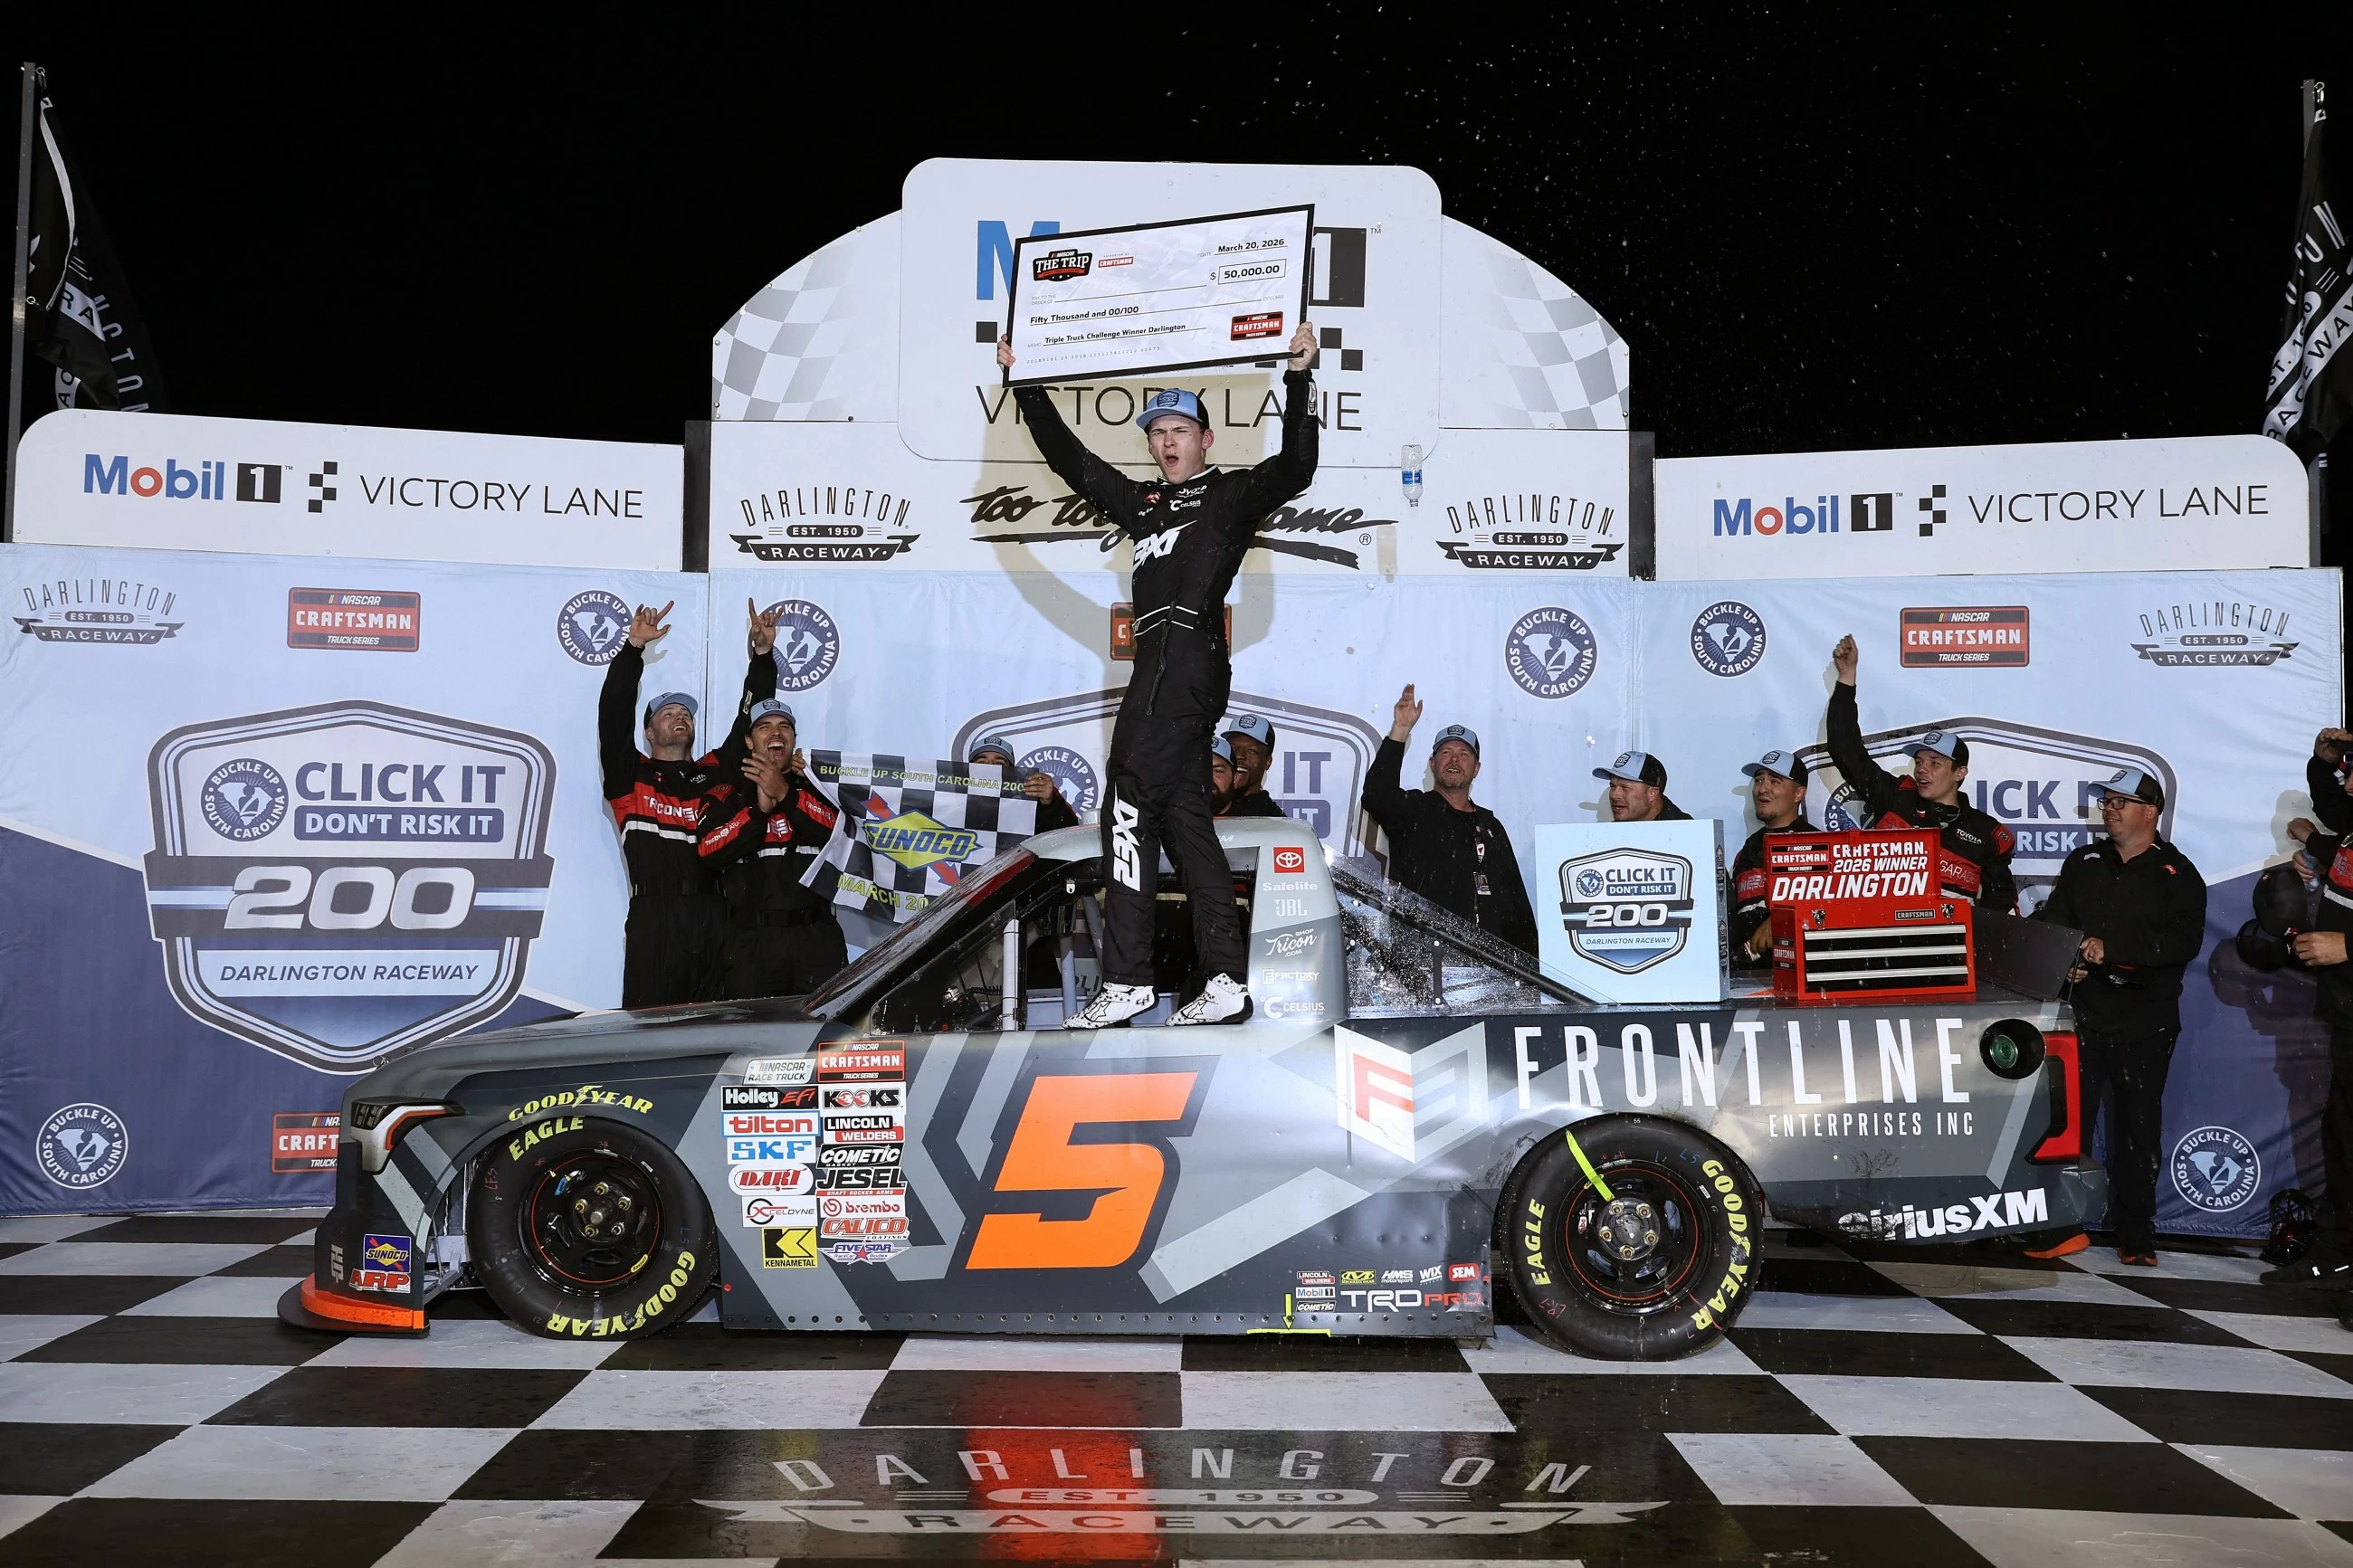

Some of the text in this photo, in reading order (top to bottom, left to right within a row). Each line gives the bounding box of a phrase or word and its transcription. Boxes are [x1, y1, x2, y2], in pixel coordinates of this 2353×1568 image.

[1218, 238, 1284, 253] March 20, 2026
[1035, 254, 1090, 273] THE TRIP
[1100, 257, 1132, 268] CRAFTSMAN
[1210, 265, 1280, 280] $ 50,000.00
[1030, 306, 1138, 325] Fifty Thousand and 00/100
[1045, 323, 1186, 346] Triple Truck Challenge Winner Darlington
[1234, 320, 1280, 332] CRAFTSMAN
[83, 453, 224, 501] Mobil
[359, 475, 643, 518] VICTORY LANE
[1968, 485, 2269, 524] VICTORY LANE
[740, 486, 911, 527] DARLINGTON
[1253, 493, 1399, 534] ame
[1446, 494, 1615, 536] DARLINGTON
[1714, 495, 1839, 537] Mobil
[792, 527, 858, 536] EST. 1950
[1498, 534, 1563, 544] EST. 1950
[771, 546, 881, 559] RACEWAY
[1476, 555, 1586, 566] RACEWAY
[24, 579, 176, 617] DARLINGTON
[341, 594, 381, 605] NASCAR
[567, 593, 626, 614] BUCKLE UP
[70, 613, 129, 622] EST. 1950
[296, 611, 412, 630] CRAFTSMAN
[1515, 611, 1587, 637] BUCKLE UP
[1699, 604, 1758, 627] BUCKLE UP
[1950, 613, 1990, 622] NASCAR
[2139, 602, 2290, 637] DARLINGTON
[51, 630, 148, 641] RACEWAY
[327, 635, 380, 645] TRUCK SERIES
[561, 622, 584, 659] SOUTH
[1907, 629, 2021, 645] CRAFTSMAN
[1694, 633, 1763, 674] SOUTH CAROLINA
[1939, 653, 1990, 661] TRUCK SERIES
[2167, 654, 2264, 664] RACEWAY
[1510, 647, 1593, 695] SOUTH CAROLINA
[211, 762, 280, 785] BUCKLE UP
[295, 762, 506, 803] CLICK IT
[820, 765, 1024, 793] BUCKLE UP SOUTH CAROLINA 200
[205, 794, 285, 838] SOUTH CAROLINA
[305, 813, 493, 836] DON'T RISK IT
[866, 824, 969, 856] SUNOCO
[1956, 828, 1983, 842] TOYOTA
[2017, 832, 2079, 852] RISK
[1772, 853, 1827, 864] CRAFTSMAN
[1833, 841, 1924, 858] CRAFTSMAN
[1605, 867, 1676, 882] CLICK IT
[1833, 857, 1928, 873] 2026 WINNER
[837, 874, 929, 912] MARCH 20
[1262, 881, 1318, 891] Safelite
[1609, 885, 1672, 894] DON'T RISK IT
[1771, 871, 1929, 901] DARLINGTON
[224, 865, 476, 931] 200
[1275, 898, 1308, 917] JBL
[1586, 903, 1669, 927] 200
[1897, 909, 1934, 919] CRAFTSMAN
[1295, 928, 1315, 937] SHOP
[1586, 937, 1634, 946] DARLINGTON
[1265, 933, 1318, 956] Tricon
[1284, 949, 1302, 957] .COM
[220, 965, 480, 982] DARLINGTON RACEWAY
[1283, 1001, 1324, 1012] CELSIUS
[852, 1043, 880, 1051] NASCAR
[768, 1061, 805, 1071] NASCAR
[822, 1055, 900, 1069] CRAFTSMAN
[1515, 1018, 1970, 1109] FRONTLINE
[748, 1073, 805, 1081] RACE TRUCK
[508, 1085, 653, 1122] GOODYEAR
[725, 1088, 817, 1107] Holley EFI
[823, 1088, 901, 1109] KOOKS
[48, 1108, 117, 1133] BUCKLE UP
[729, 1116, 813, 1134] tilton
[827, 1117, 890, 1130] LINCOLN
[1769, 1112, 1975, 1137] ENTERPRISES INC
[508, 1116, 585, 1162] EAGLE
[842, 1130, 897, 1141] WELDERS
[731, 1140, 812, 1160] SKF
[820, 1144, 901, 1164] COMETIC
[43, 1139, 122, 1183] SOUTH CAROLINA
[965, 1071, 1199, 1270] 5
[738, 1167, 808, 1187] DART
[817, 1168, 905, 1189] JESEL
[845, 1201, 900, 1214] brembo
[823, 1218, 908, 1235] CALICO
[1524, 1199, 1551, 1286] EAGLE
[1691, 1159, 1751, 1331] GOODYEAR
[367, 1250, 407, 1260] SUNOCO
[765, 1259, 815, 1268] KENNAMETAL
[350, 1269, 410, 1288] ARP
[1381, 1269, 1414, 1278] HMS
[1419, 1265, 1442, 1279] WIX
[1453, 1266, 1475, 1278] SEM
[547, 1250, 696, 1336] GOODYEAR
[1297, 1288, 1323, 1297] Mobil
[1340, 1289, 1481, 1313] TRD PRO
[1297, 1302, 1335, 1311] COMETIC
[773, 1448, 1592, 1494] DARLINGTON
[1021, 1491, 1346, 1502] EST. 1950
[906, 1515, 1469, 1530] RACEWAY
